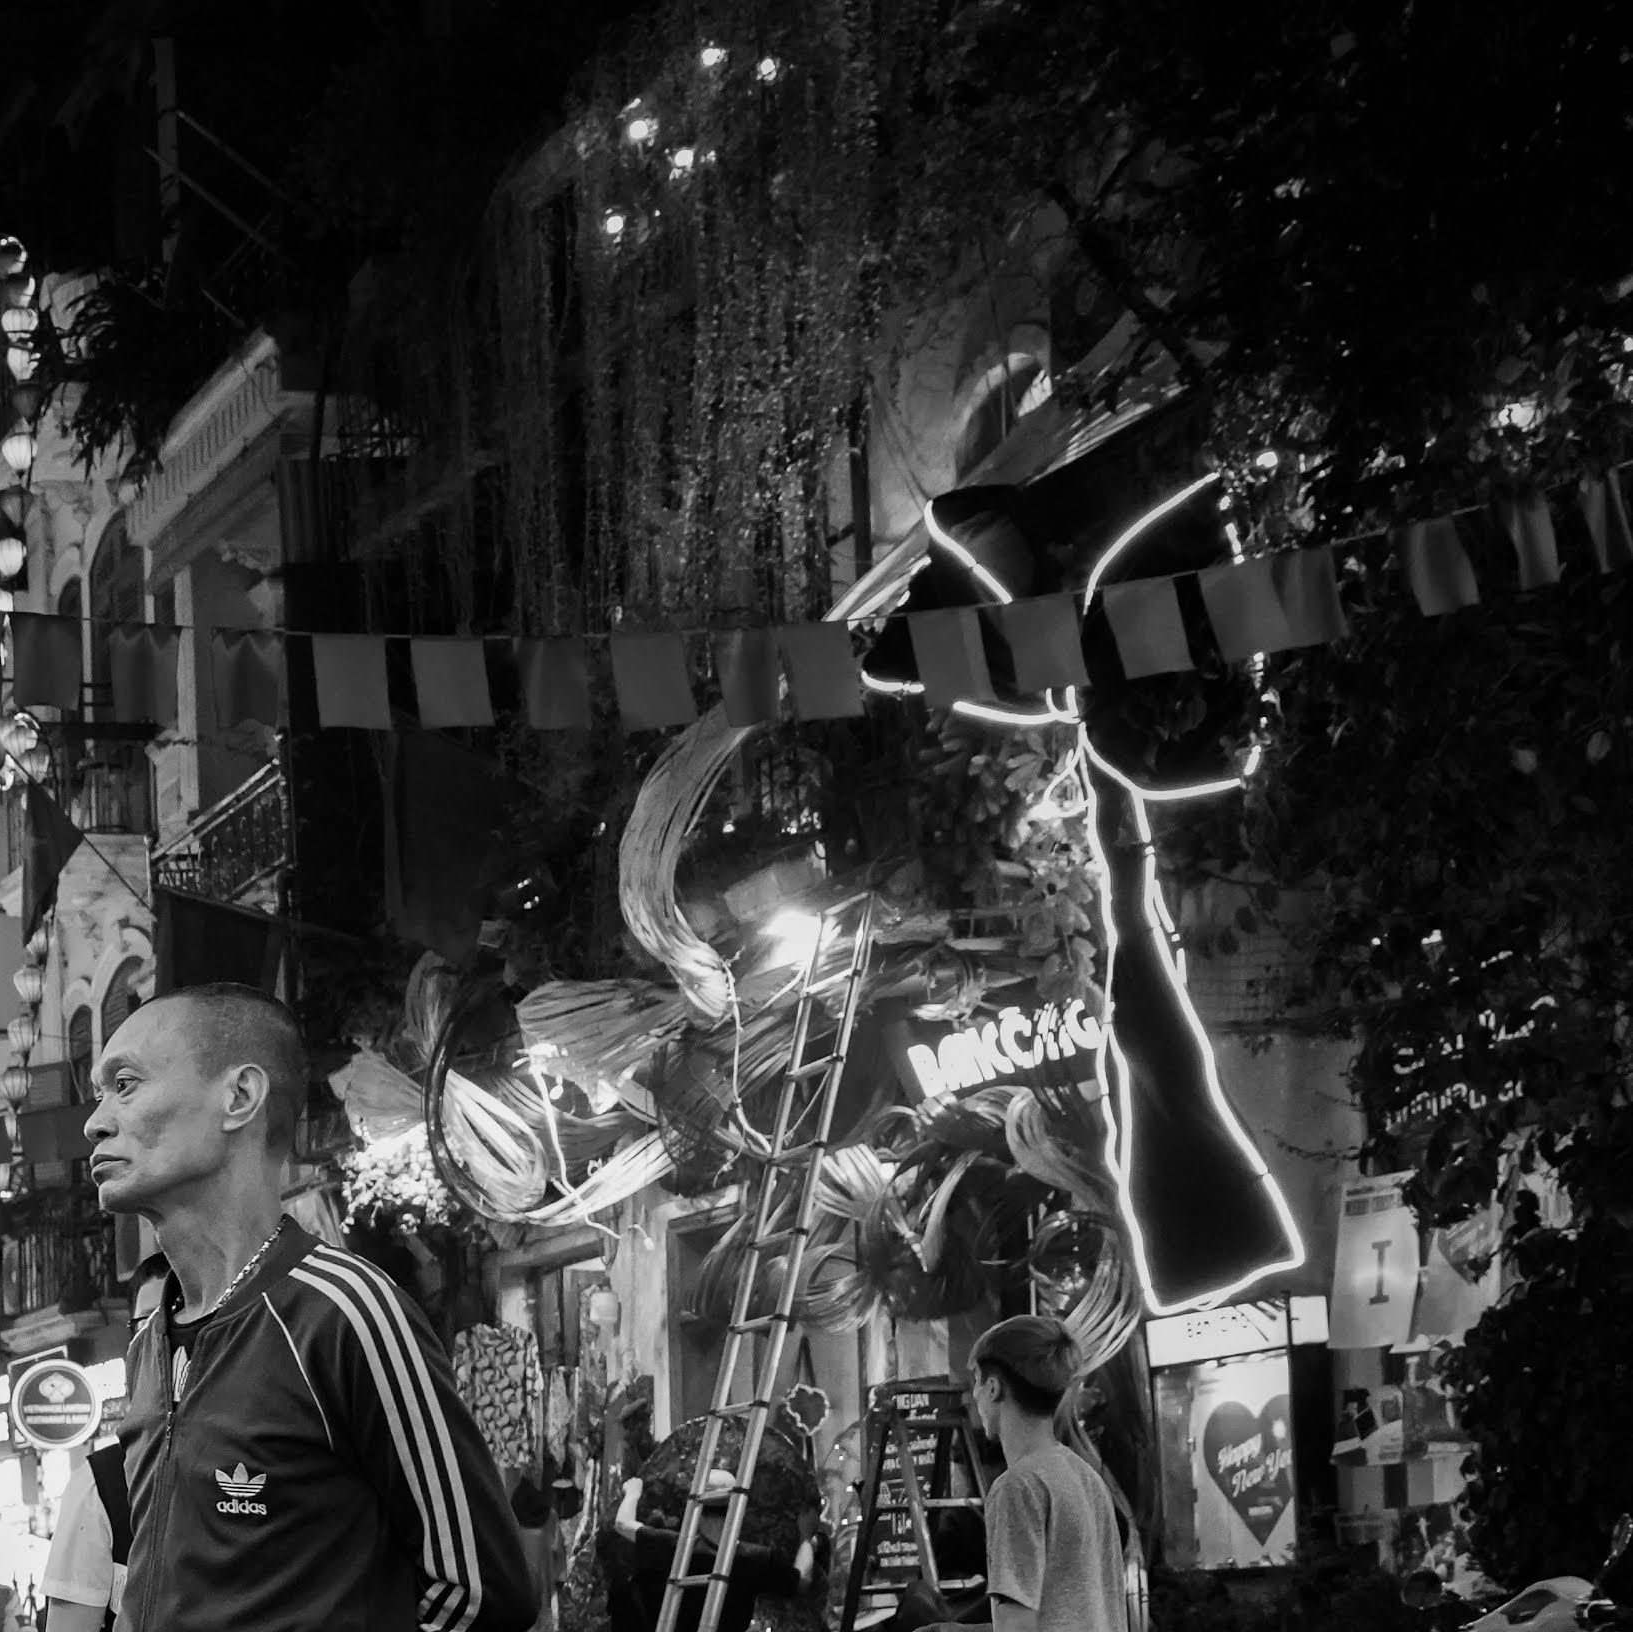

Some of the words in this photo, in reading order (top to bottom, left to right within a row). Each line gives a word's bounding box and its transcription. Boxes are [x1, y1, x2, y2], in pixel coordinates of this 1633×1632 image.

[1218, 1433, 1262, 1475] Happy
[1232, 1463, 1266, 1498] New
[216, 1497, 268, 1516] adidas
